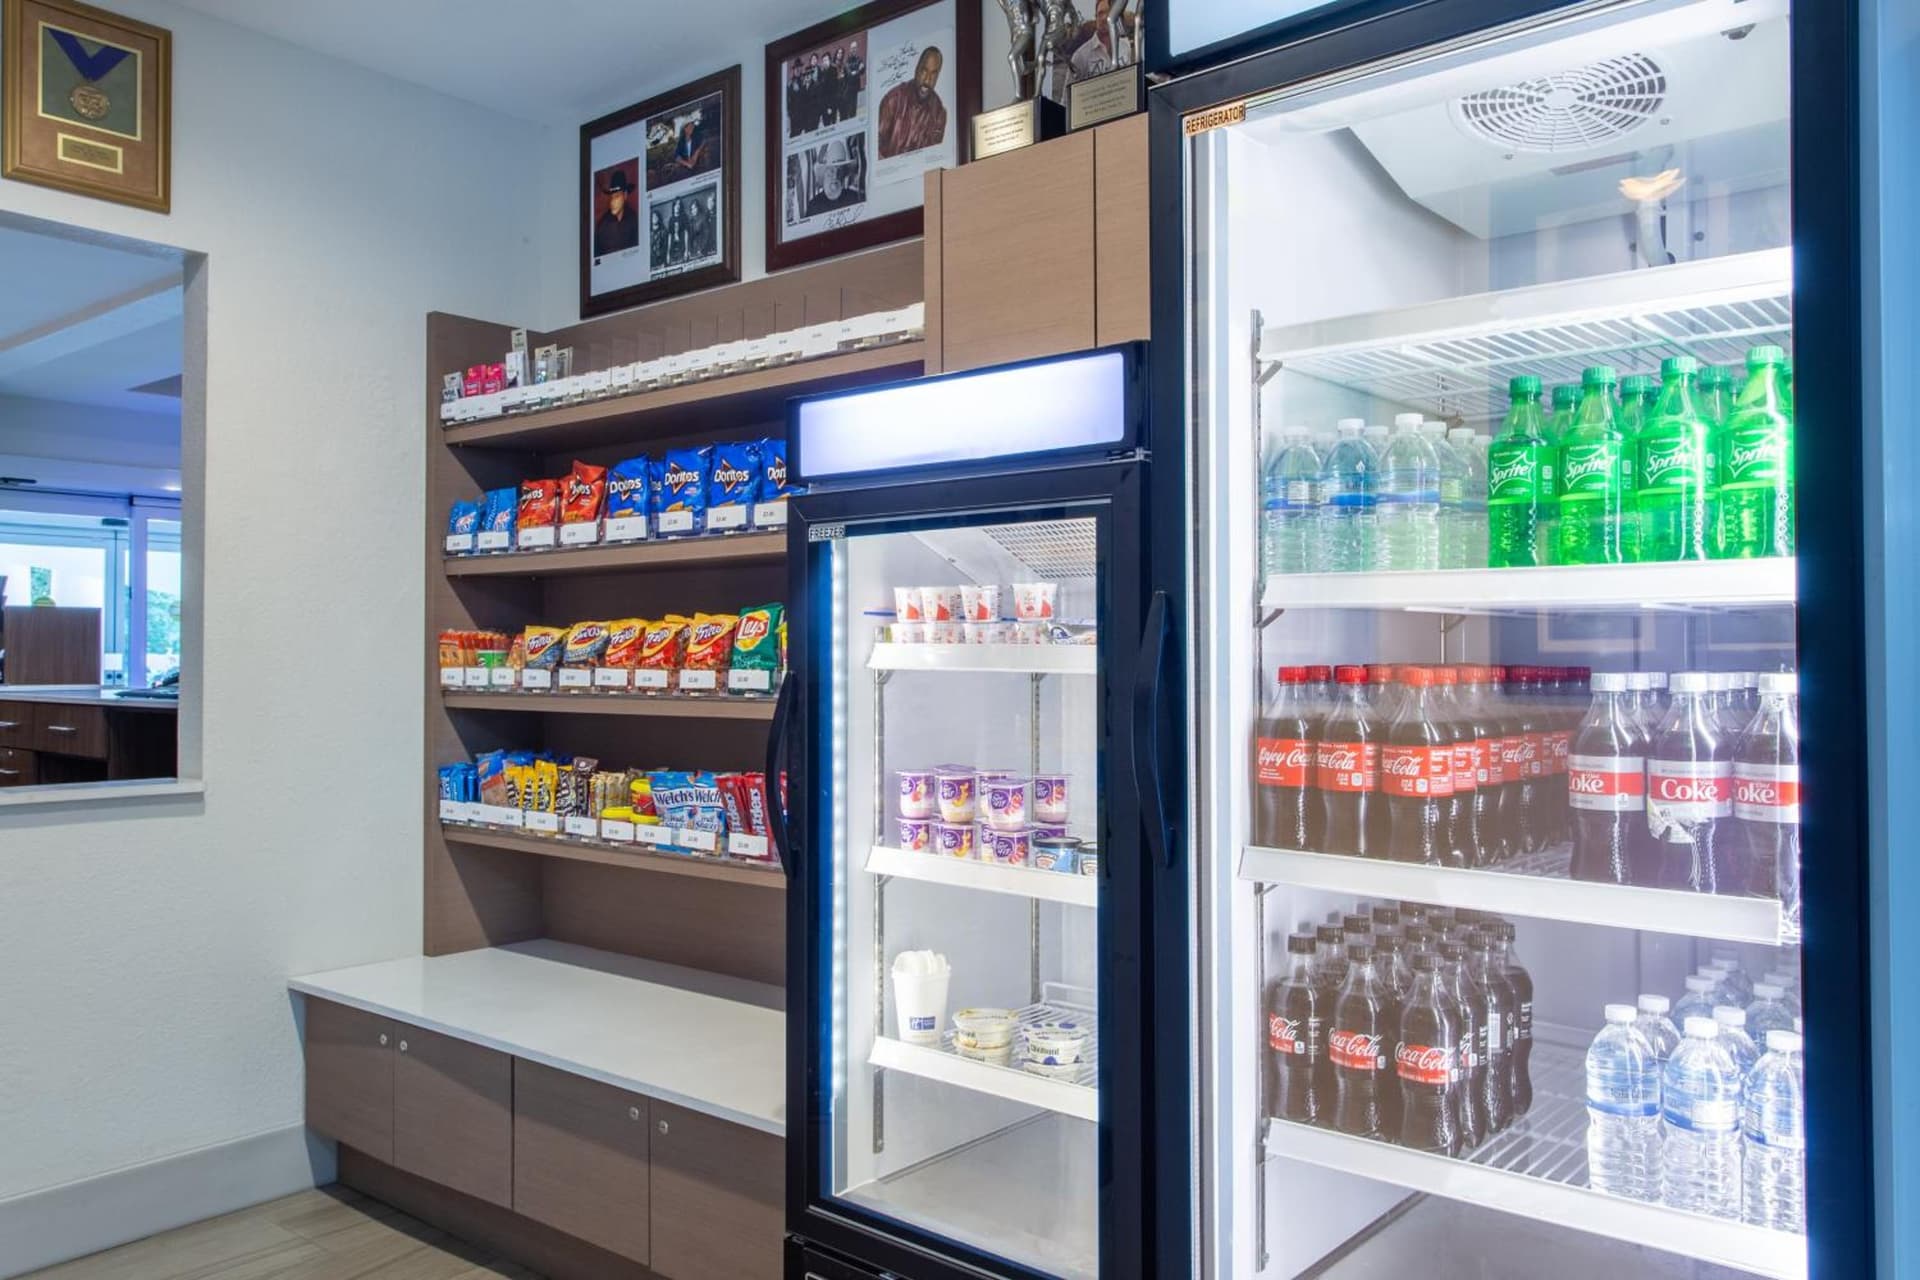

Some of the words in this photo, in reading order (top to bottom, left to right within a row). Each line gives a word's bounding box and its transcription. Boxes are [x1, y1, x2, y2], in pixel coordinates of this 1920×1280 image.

[1186, 105, 1244, 133] REFRIGERATOR
[714, 469, 749, 483] Doritos
[1491, 463, 1531, 485] Sprite
[1566, 457, 1612, 479] Sprite
[664, 470, 699, 486] Doritos
[810, 526, 845, 539] FREEZER
[654, 788, 694, 805] Welch's
[1661, 778, 1718, 800] Coke
